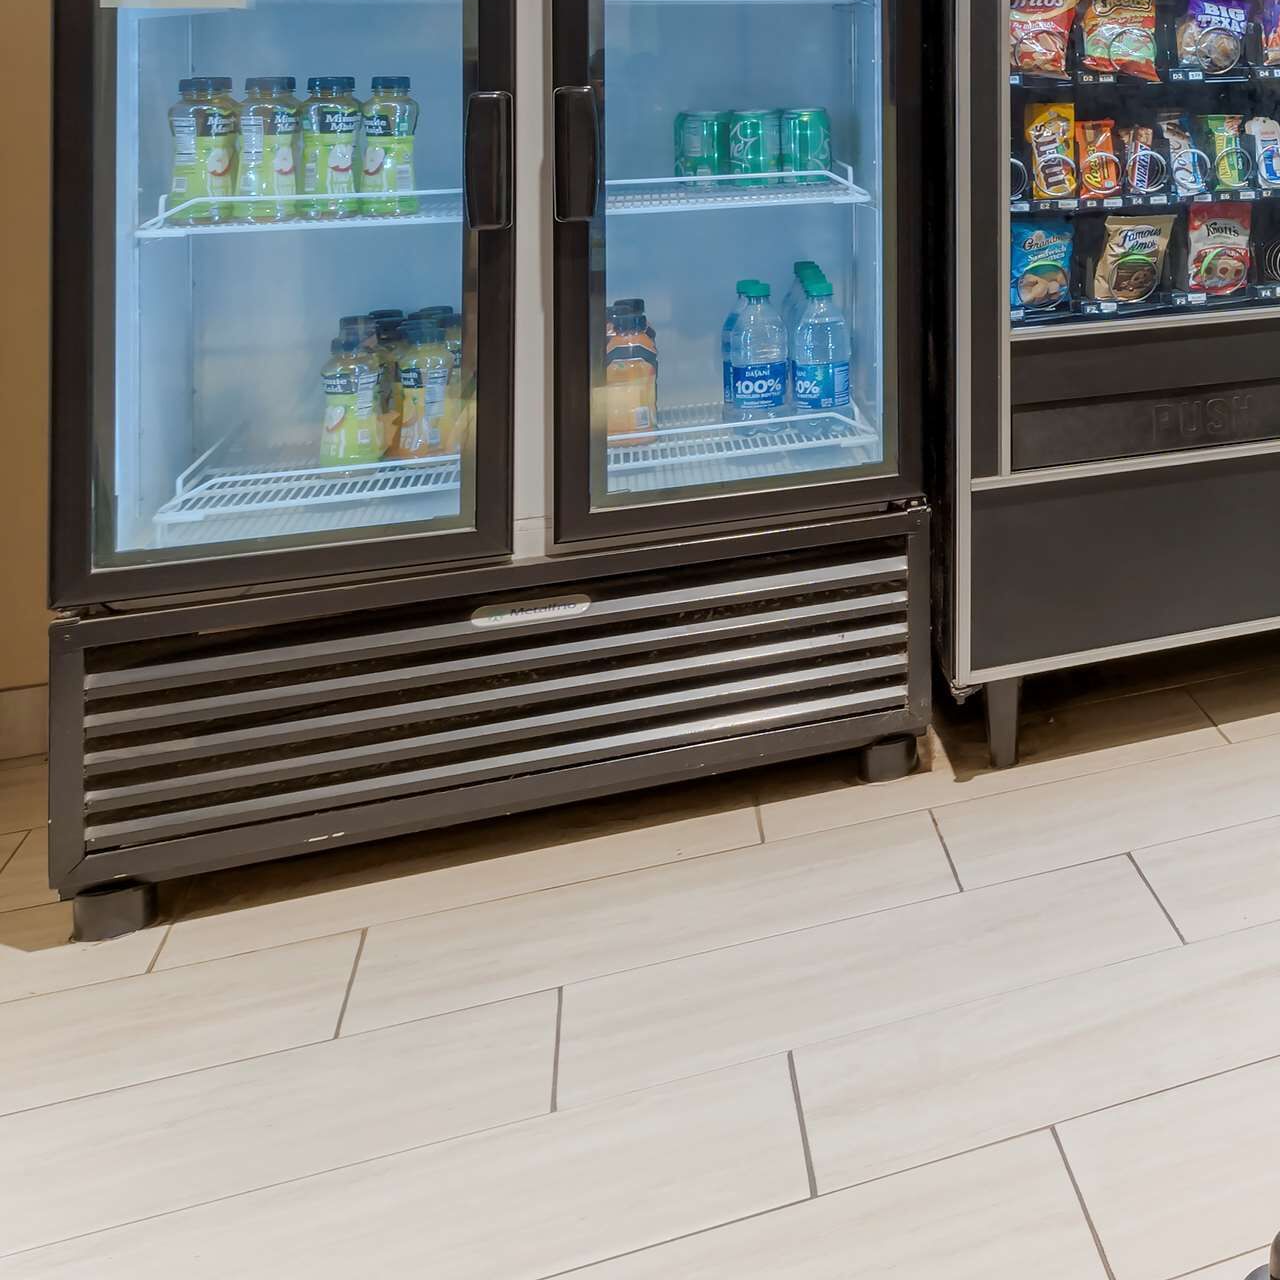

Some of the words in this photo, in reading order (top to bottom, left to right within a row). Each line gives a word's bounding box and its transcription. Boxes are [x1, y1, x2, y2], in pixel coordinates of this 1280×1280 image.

[1203, 1, 1245, 21] BIG
[1197, 14, 1247, 34] TEXAS
[1118, 226, 1162, 248] Famous
[1205, 221, 1240, 237] Knott's
[735, 377, 782, 394] 100%
[1151, 394, 1254, 441] PUSH
[510, 602, 576, 617] Metalfrio
